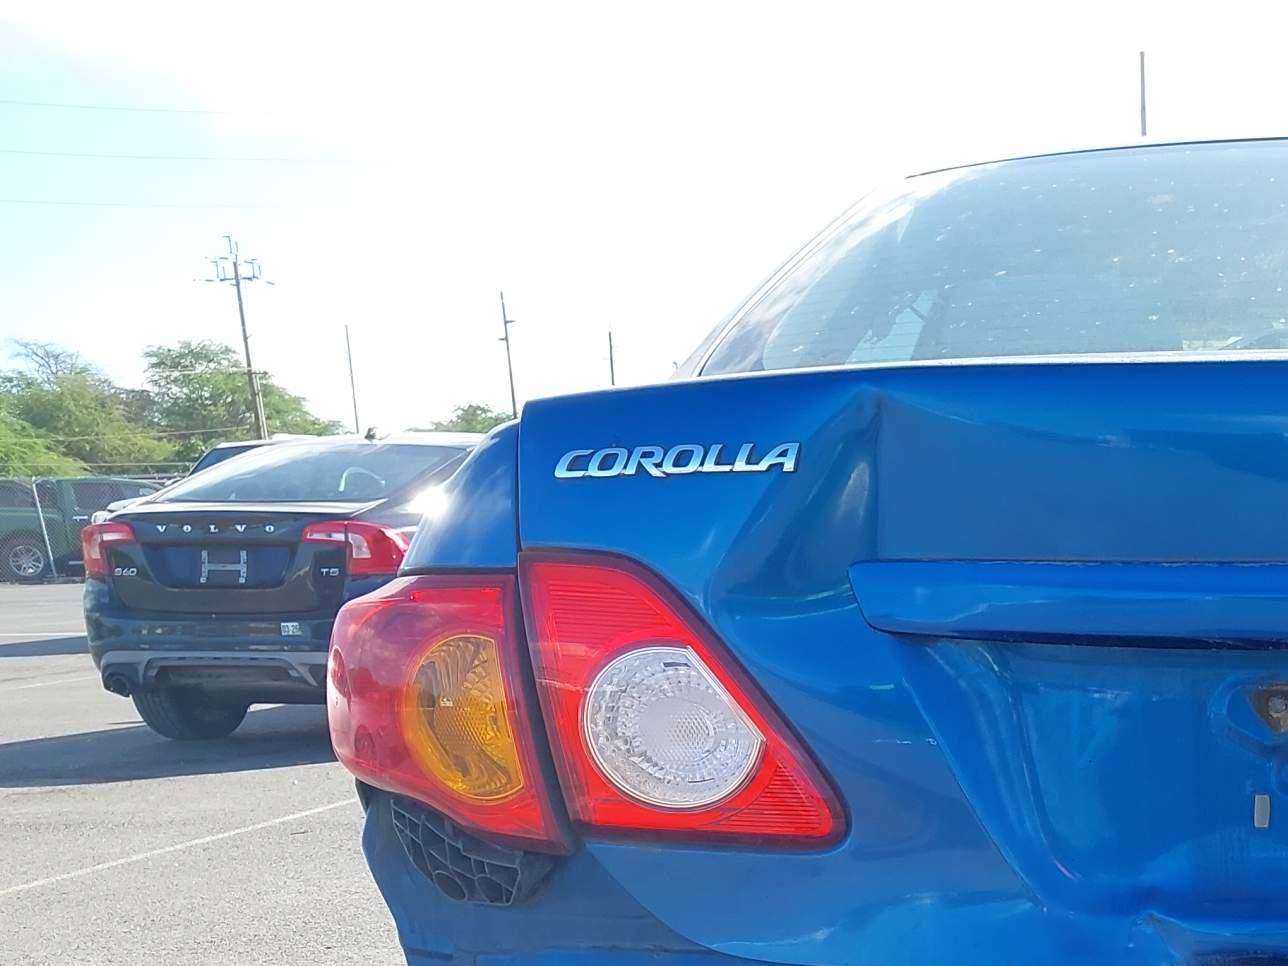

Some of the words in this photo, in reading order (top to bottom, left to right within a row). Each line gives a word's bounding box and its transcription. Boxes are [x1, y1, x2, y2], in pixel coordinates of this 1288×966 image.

[553, 442, 800, 478] COROLLA
[156, 524, 275, 532] VOLVO
[114, 567, 137, 576] S60
